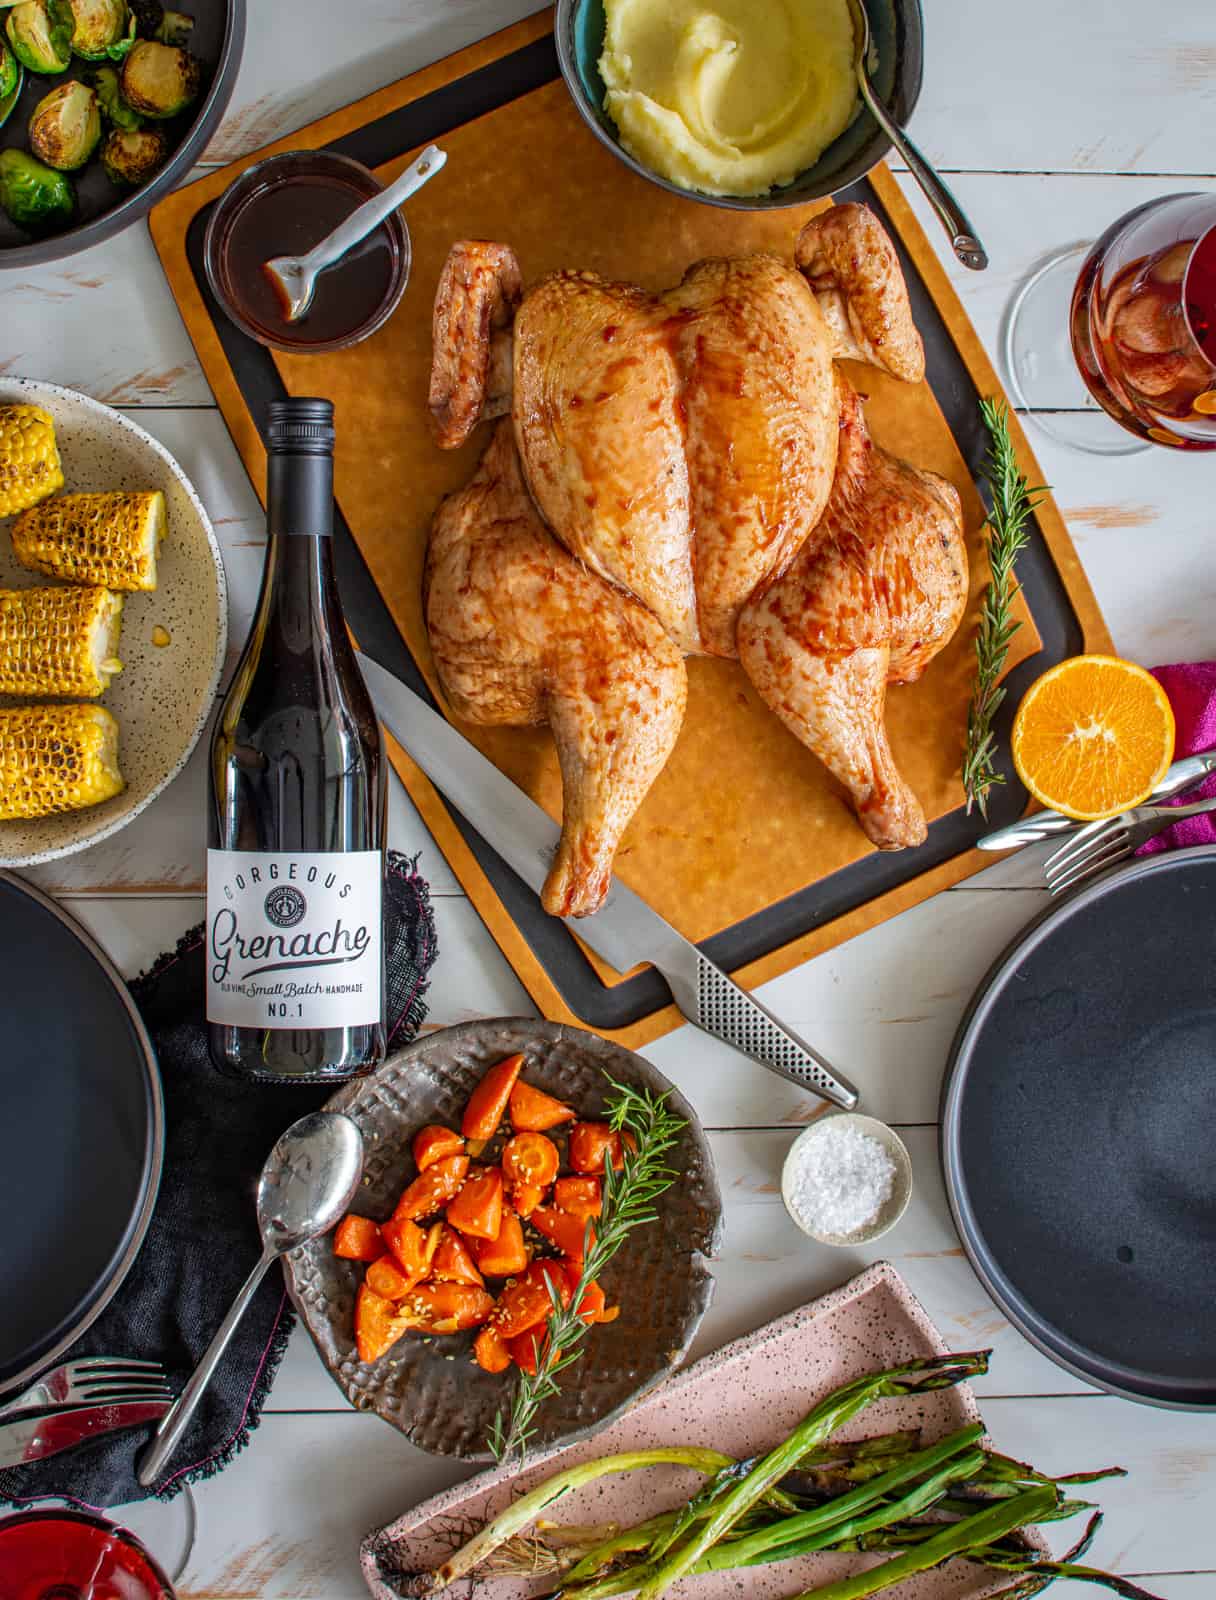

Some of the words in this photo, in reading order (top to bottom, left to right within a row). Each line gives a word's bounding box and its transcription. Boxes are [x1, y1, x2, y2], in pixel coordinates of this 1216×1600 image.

[223, 863, 352, 900] GORGEOUS
[212, 908, 371, 983] Grenache
[246, 982, 283, 998] Small
[283, 982, 323, 998] Batch
[325, 983, 363, 994] HANDMADE
